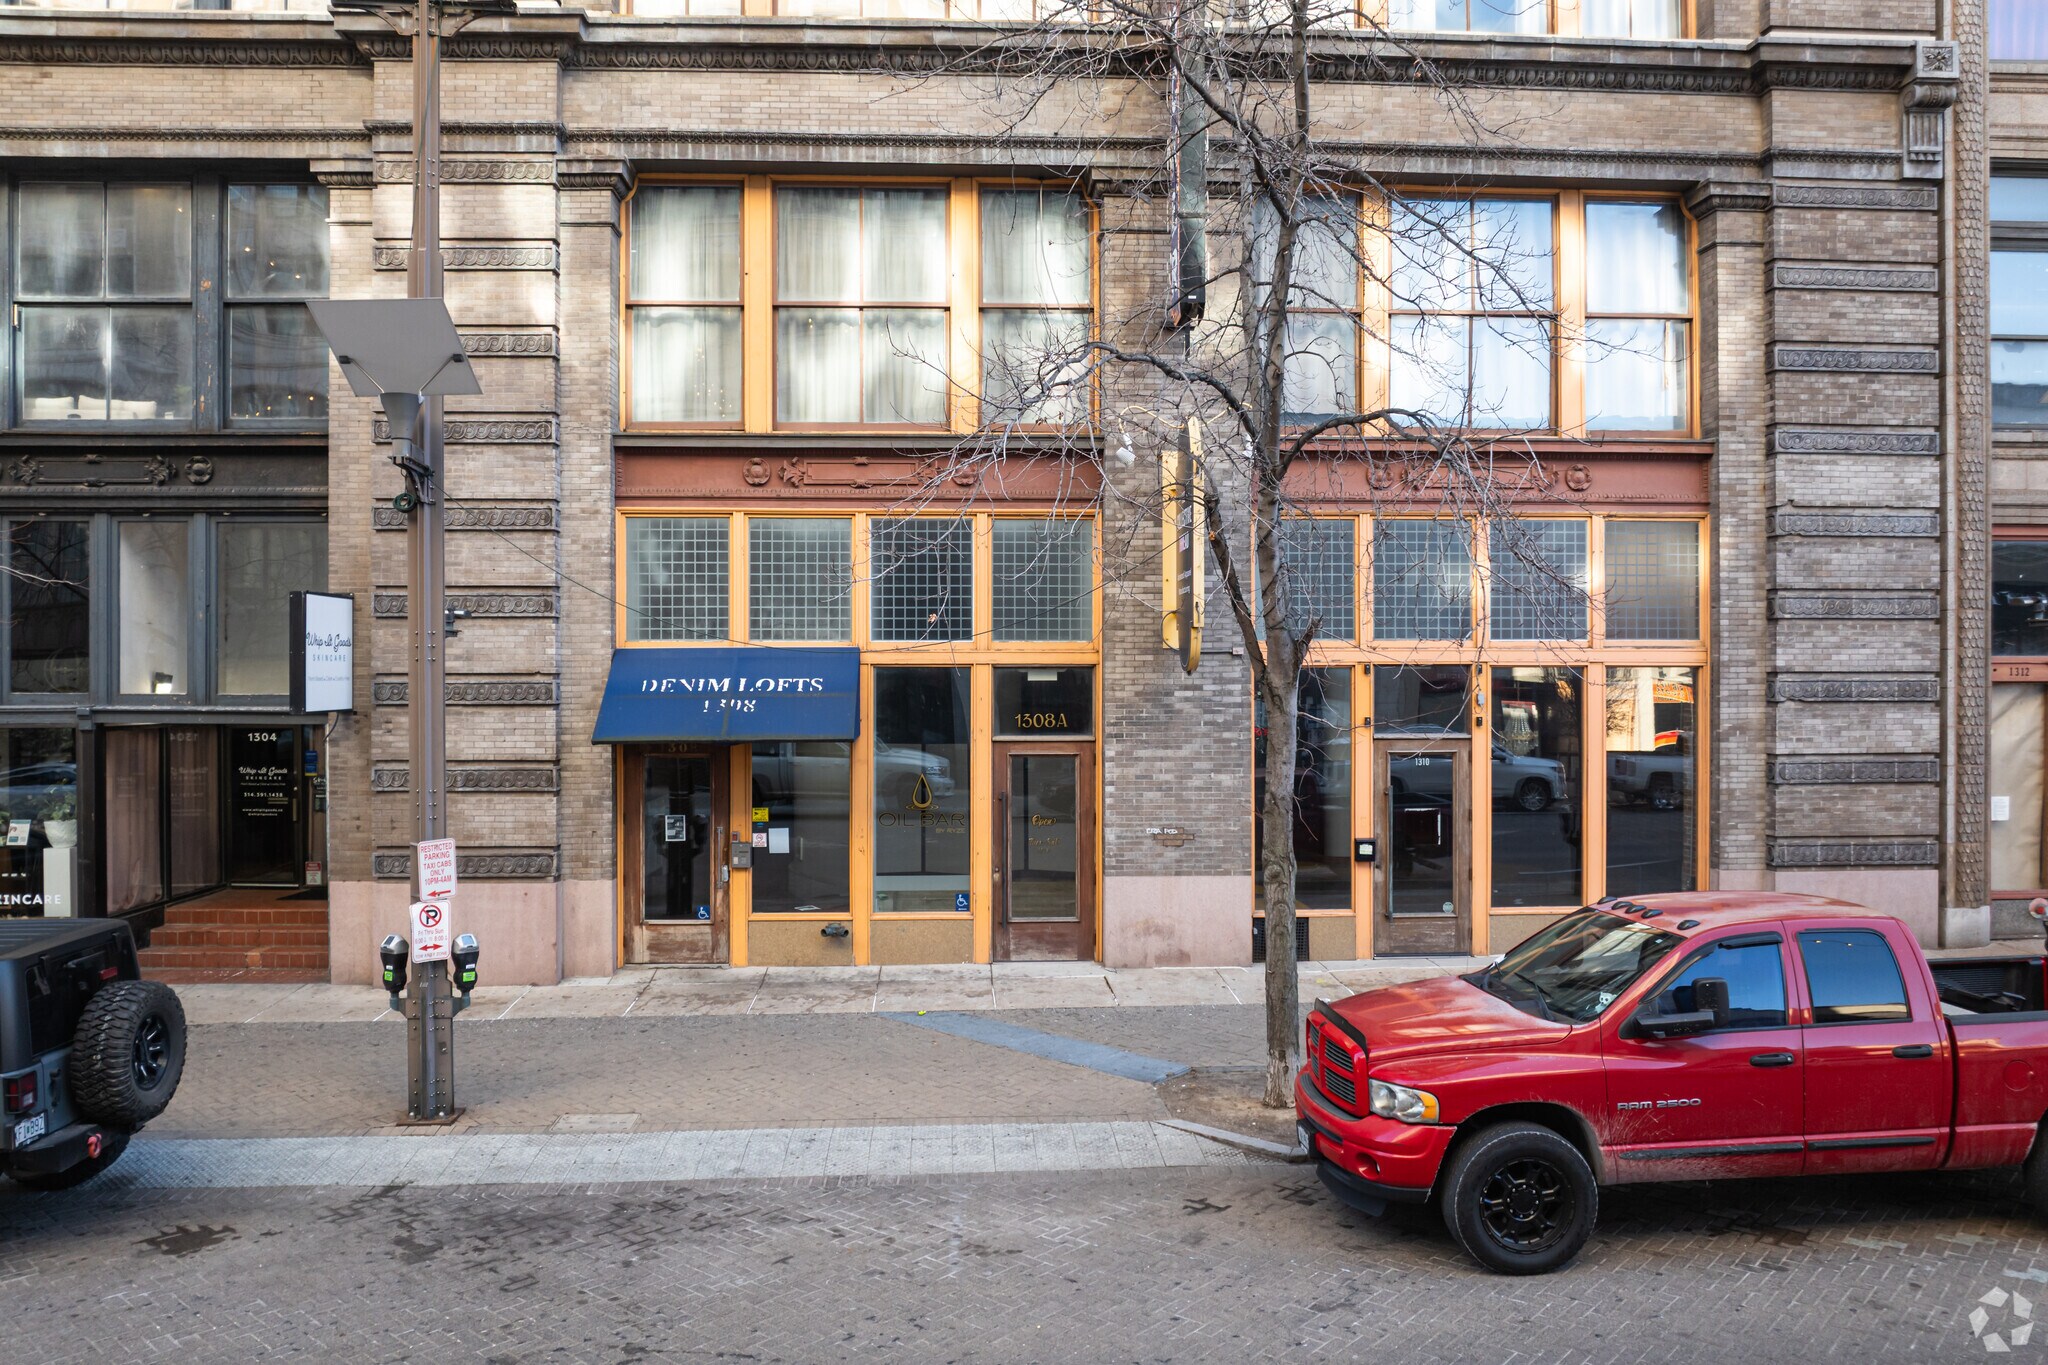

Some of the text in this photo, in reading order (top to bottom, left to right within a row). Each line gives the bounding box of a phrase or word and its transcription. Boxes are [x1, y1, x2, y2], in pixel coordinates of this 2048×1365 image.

[2009, 667, 2030, 676] 1312
[642, 678, 823, 692] DENIM LOFTS
[1014, 714, 1068, 728] 1308A
[248, 732, 277, 742] 1304
[1415, 758, 1430, 766] 1310
[239, 766, 256, 774] Whip
[268, 766, 288, 776] Goods
[879, 812, 965, 828] OIL BAR
[420, 842, 452, 853] RESTRICTED
[424, 851, 450, 860] PARKING
[430, 868, 444, 876] ONLY
[1618, 1098, 1701, 1110] RAM 2500
